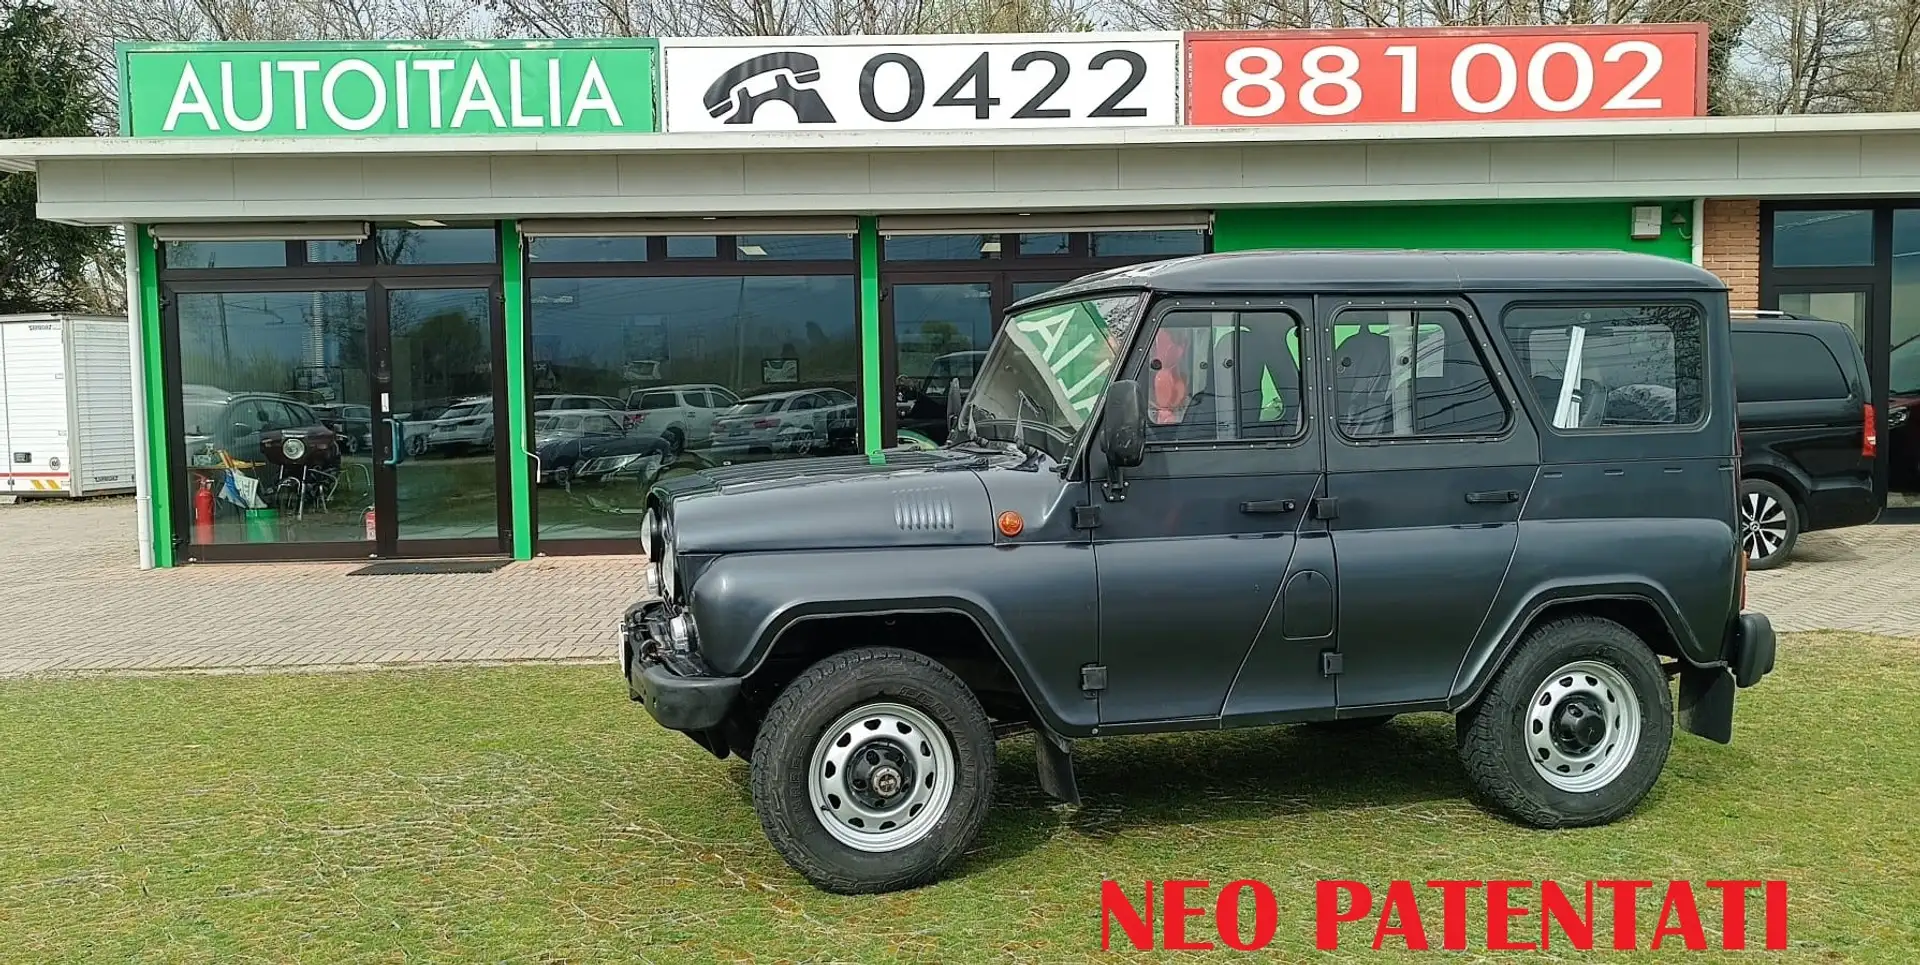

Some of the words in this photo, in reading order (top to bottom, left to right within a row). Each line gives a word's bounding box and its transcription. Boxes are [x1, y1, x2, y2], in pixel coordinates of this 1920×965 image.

[162, 57, 624, 132] AUTOITALIA
[858, 49, 1148, 123] 0422
[1220, 40, 1664, 118] 881002
